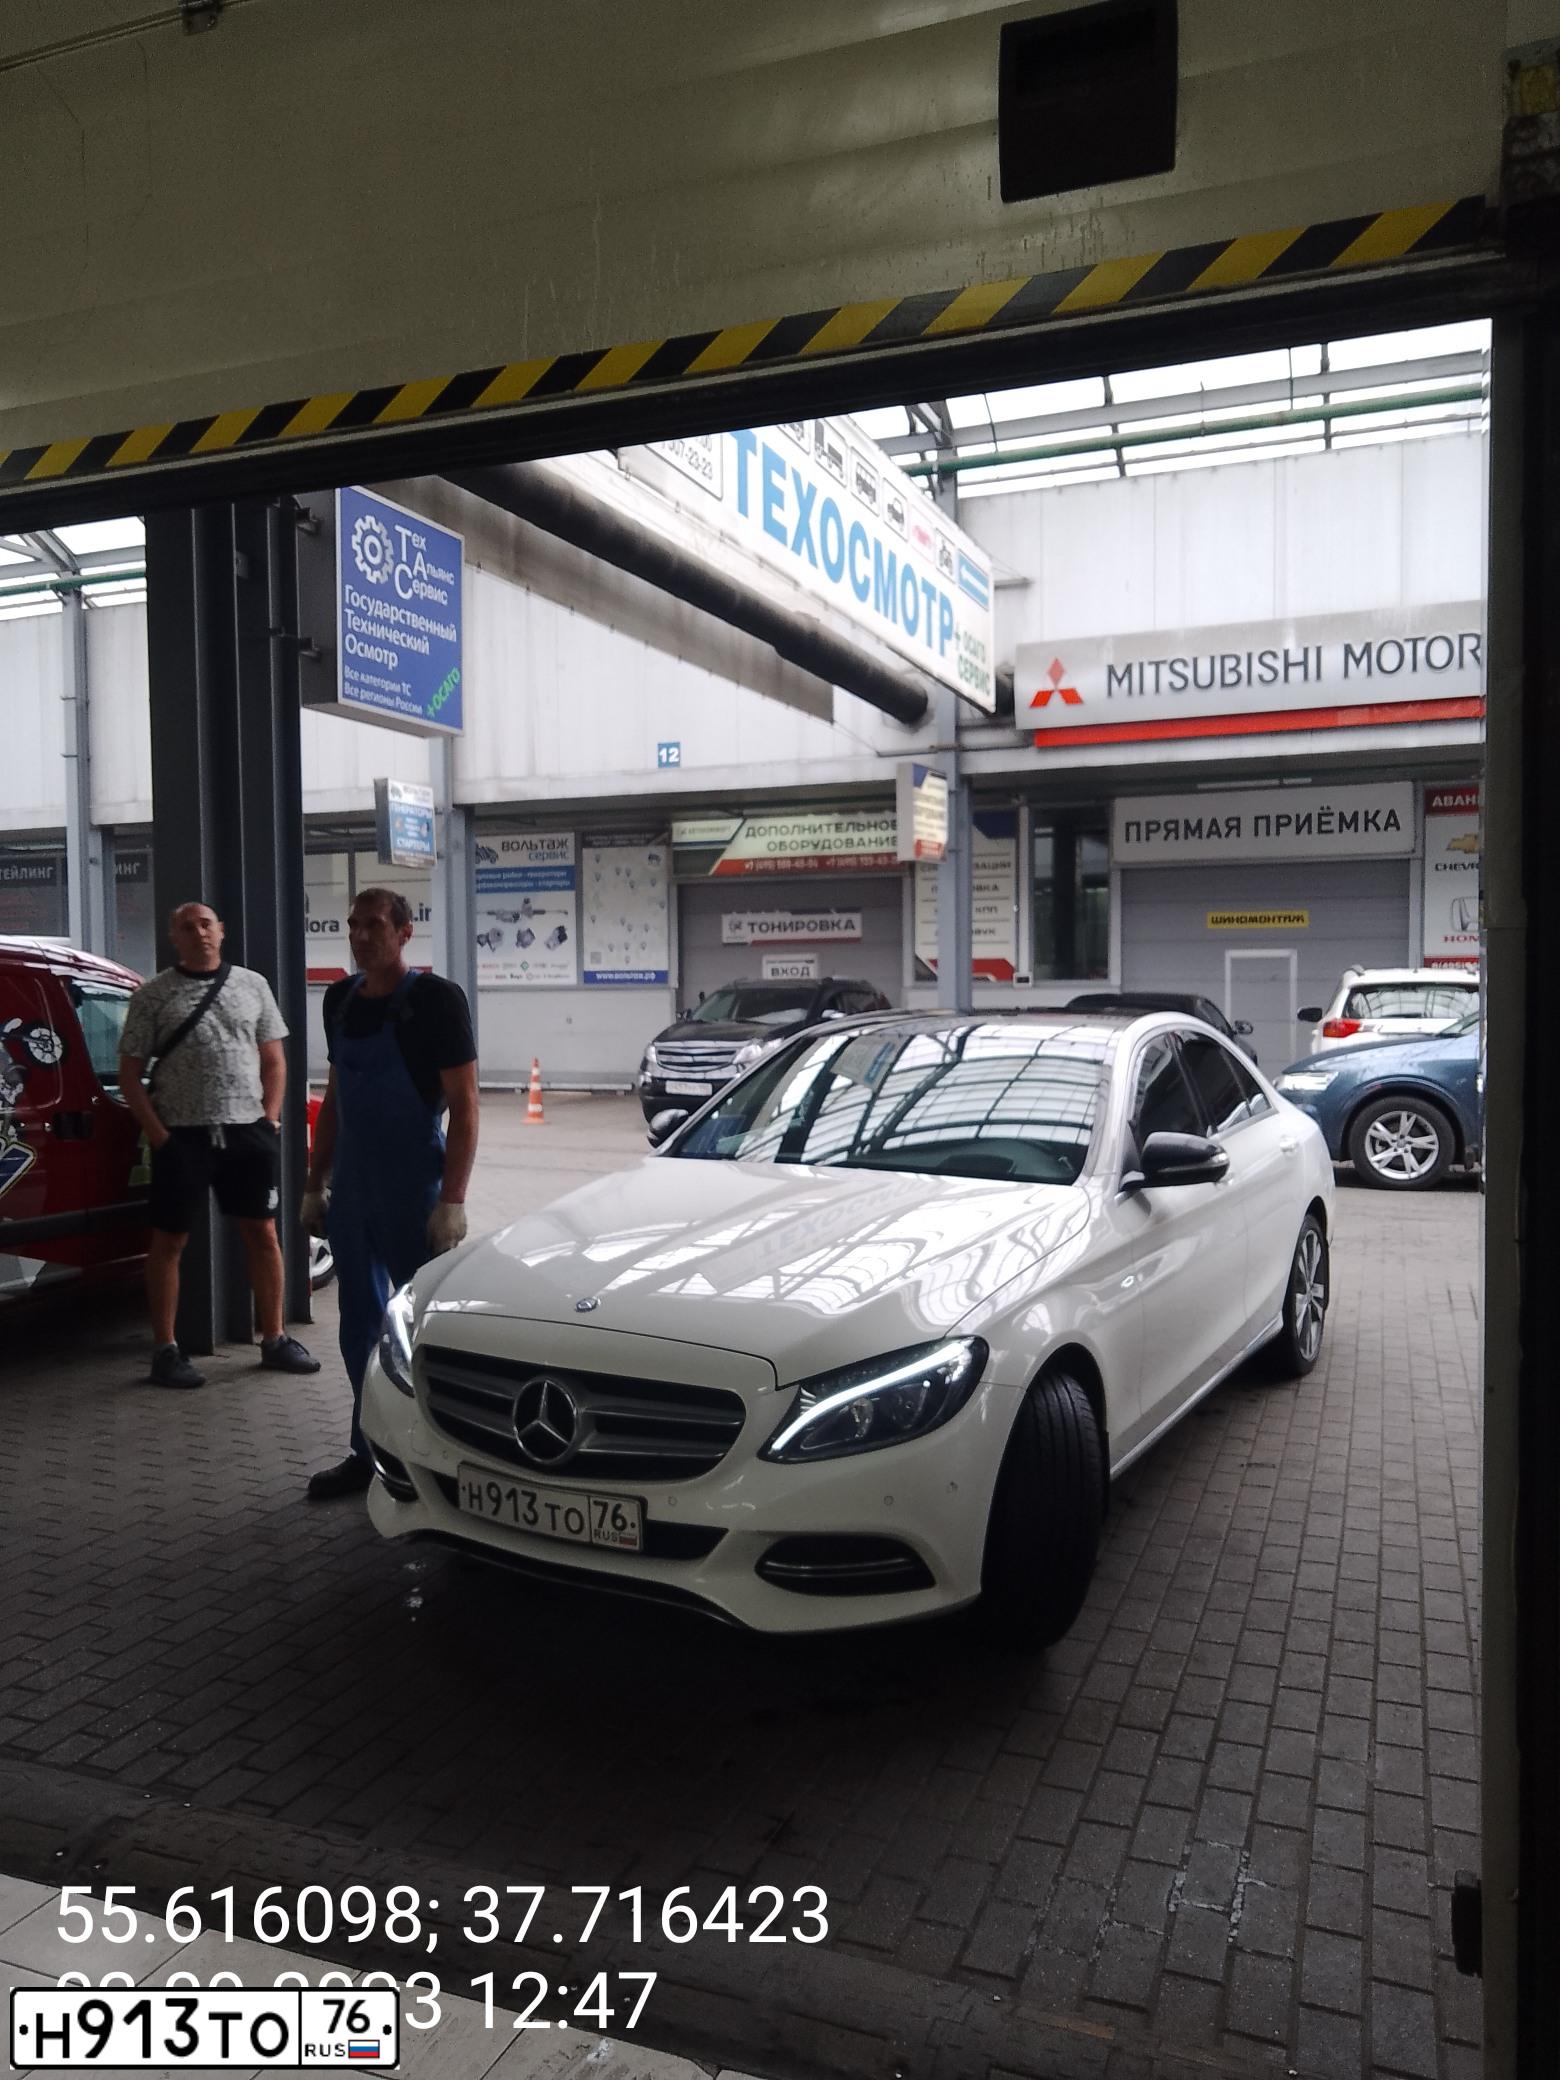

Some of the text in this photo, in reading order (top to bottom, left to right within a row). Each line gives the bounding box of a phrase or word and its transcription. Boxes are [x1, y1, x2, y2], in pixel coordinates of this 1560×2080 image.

[730, 430, 954, 657] ТЕХОСМОТР
[395, 563, 448, 606] Сервис
[344, 584, 457, 642] Государственный
[344, 608, 430, 655] Технический
[344, 633, 399, 670] Осмотр
[1106, 633, 1481, 698] MITSUBISHI MOTOR
[344, 665, 412, 696] Все категории ТС
[344, 681, 360, 697] Все
[395, 695, 423, 714] России
[659, 747, 680, 762] 12
[1432, 794, 1480, 807] АВАН
[745, 819, 897, 838] ДОПОЛНИТЕЛЬНОЕ
[1125, 805, 1401, 843] ПРЯМАЯ ПРИЁМКА
[766, 836, 897, 852] ОБОРУДОВАНИЕ
[747, 919, 856, 934] ТОНИРОВКА
[771, 967, 811, 977] ВХОД
[593, 1499, 628, 1532] 76
[593, 1529, 618, 1543] RUS
